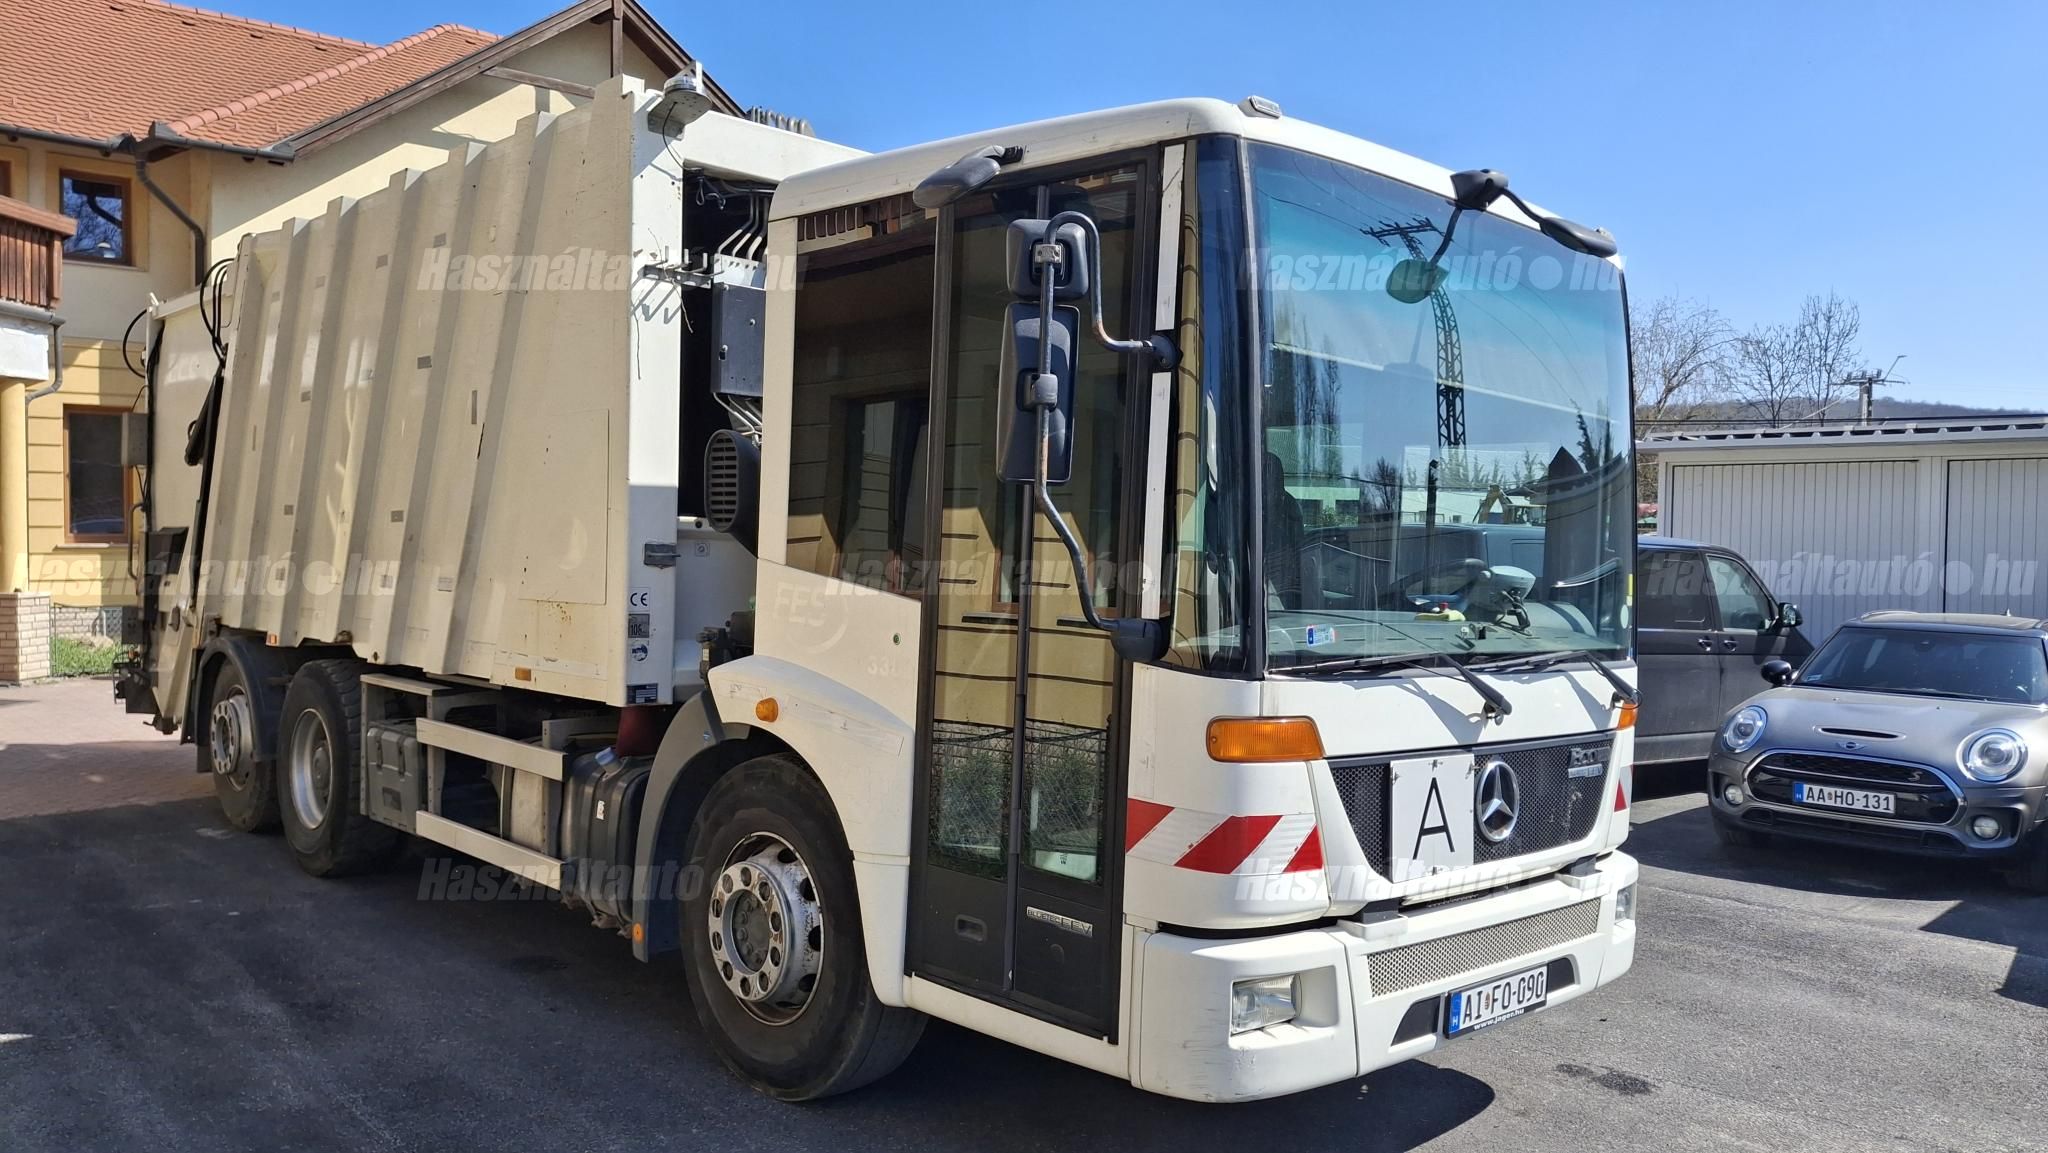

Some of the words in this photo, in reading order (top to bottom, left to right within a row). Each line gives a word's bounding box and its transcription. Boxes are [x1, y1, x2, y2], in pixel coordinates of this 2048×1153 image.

[630, 593, 648, 606] CE
[1412, 776, 1455, 861] A
[1474, 1008, 1525, 1031] www.jager.hu
